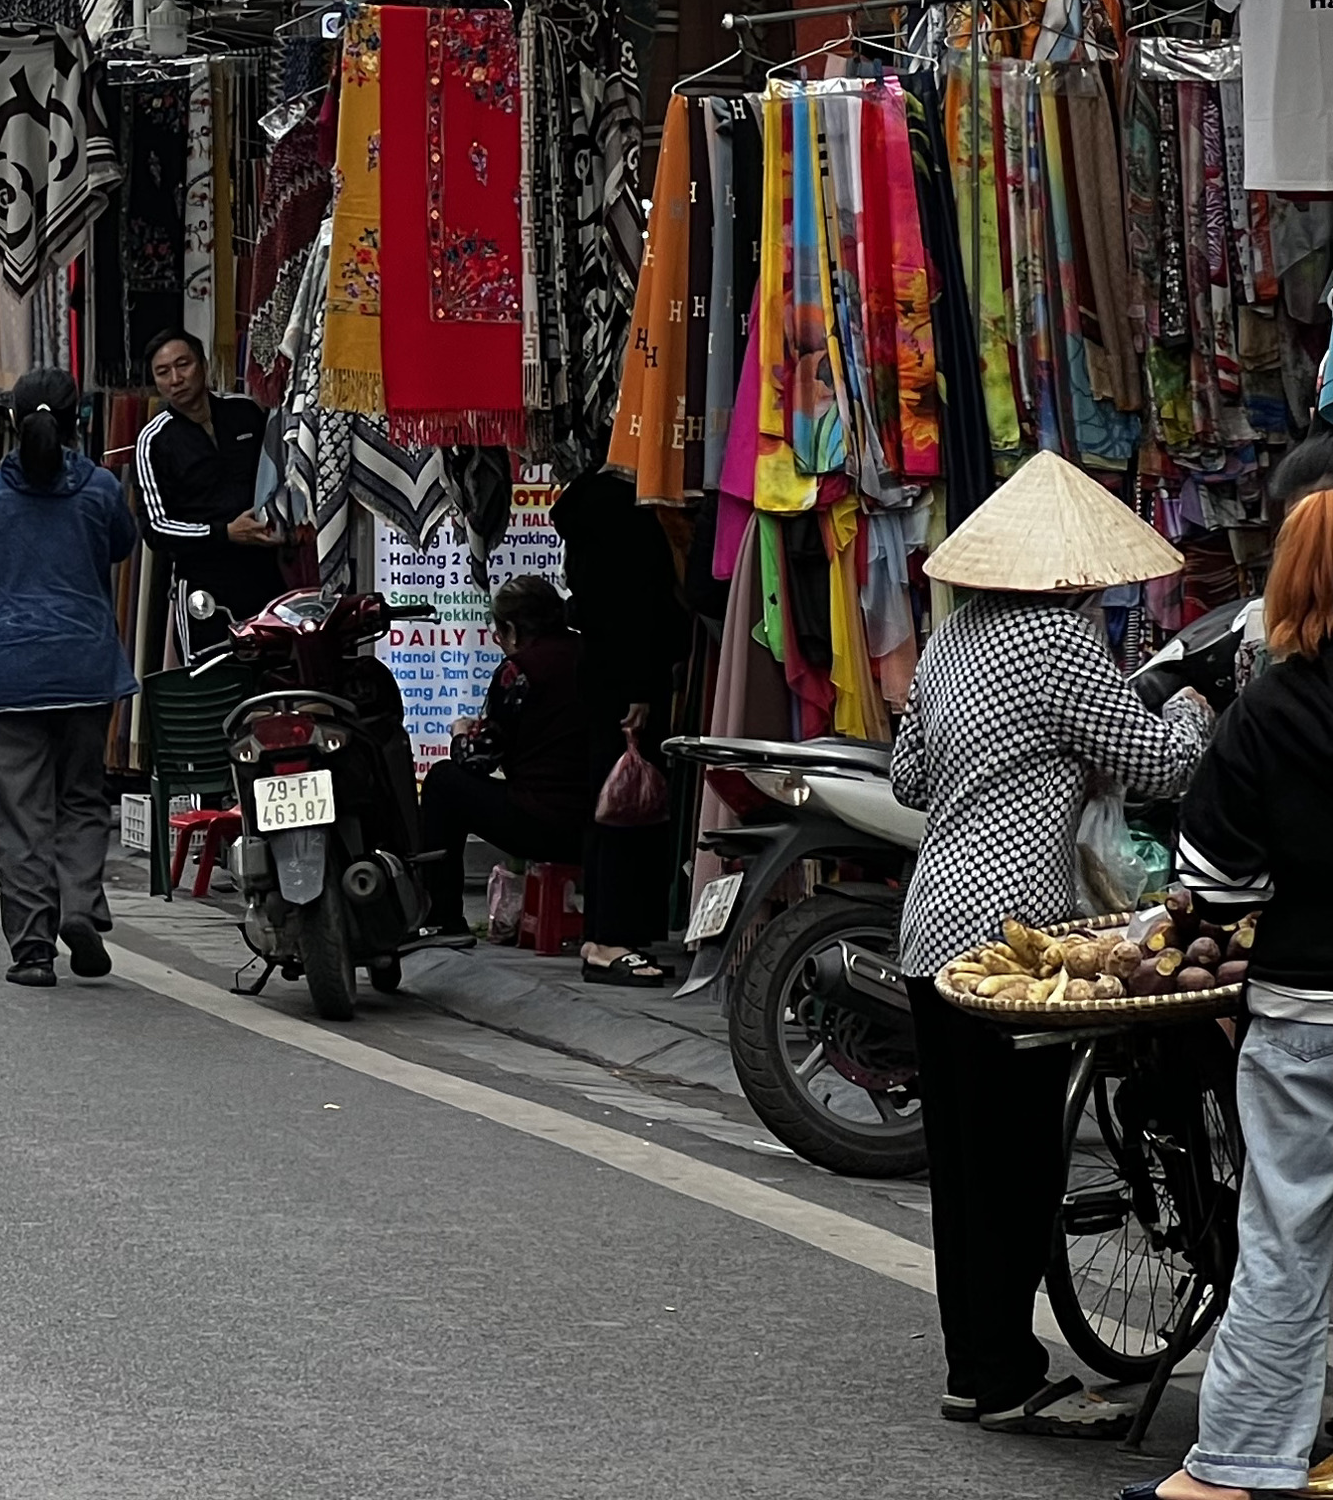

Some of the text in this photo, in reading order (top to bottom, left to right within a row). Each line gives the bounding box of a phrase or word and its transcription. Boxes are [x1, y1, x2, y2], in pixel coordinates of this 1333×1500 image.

[390, 552, 447, 569] Halong
[451, 553, 461, 565] 2
[510, 553, 515, 565] 1
[390, 571, 445, 588] Halong
[450, 572, 458, 585] 3
[390, 591, 492, 606] Sapa trekking
[390, 629, 466, 647] DAILY
[391, 651, 436, 664] Hanoi
[440, 651, 470, 665] City
[442, 667, 469, 680] Tam
[399, 687, 433, 700] rang
[438, 685, 458, 698] An
[403, 703, 452, 716] erfume
[419, 744, 450, 756] Train
[266, 775, 319, 802] 29-F1
[262, 798, 327, 827] 463.87
